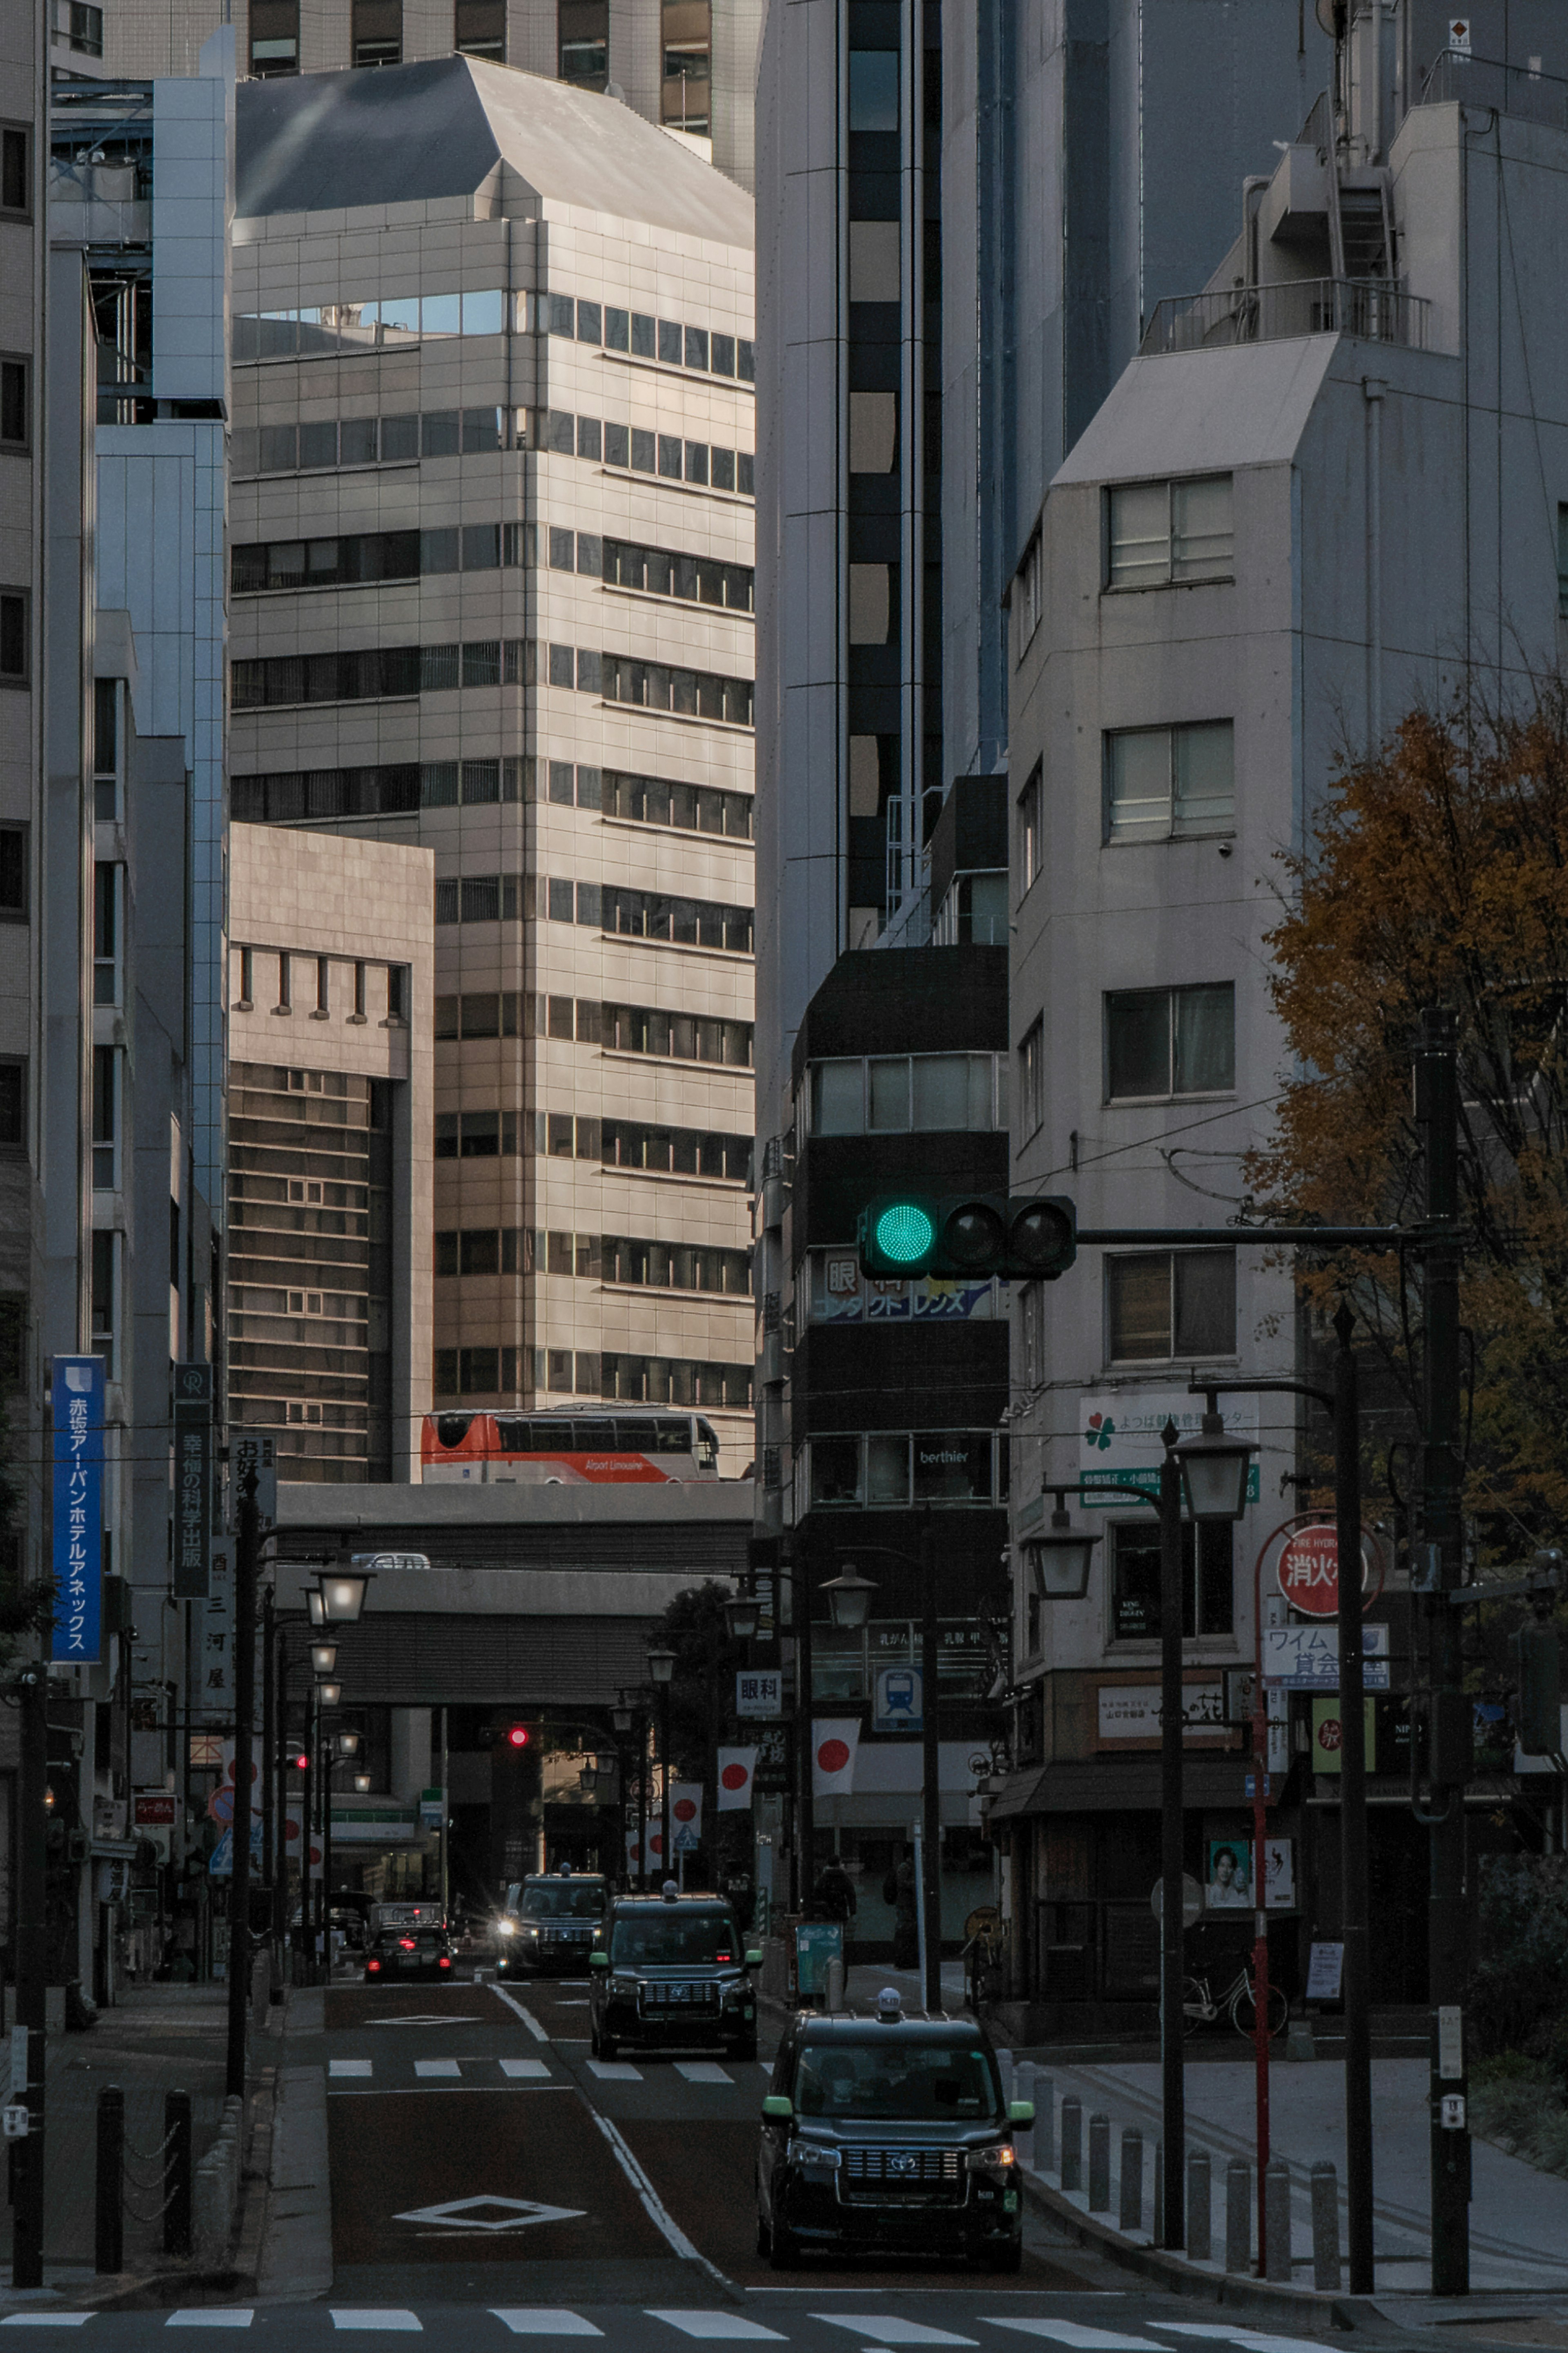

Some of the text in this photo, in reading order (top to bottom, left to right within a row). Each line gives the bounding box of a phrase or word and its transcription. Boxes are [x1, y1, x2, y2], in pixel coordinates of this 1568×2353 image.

[586, 1459, 643, 1472] Airport Limousine
[920, 1450, 969, 1463] berthier
[181, 1434, 201, 1568] 幸福の科学出版
[69, 1398, 88, 1650] 赤坂アーバンホテルアネックス
[1293, 1538, 1311, 1548] FIRE
[1286, 1553, 1339, 1587] 消火
[206, 1596, 227, 1689] 三河屋
[1270, 1630, 1327, 1651] ワイム
[742, 1678, 776, 1700] 眼科
